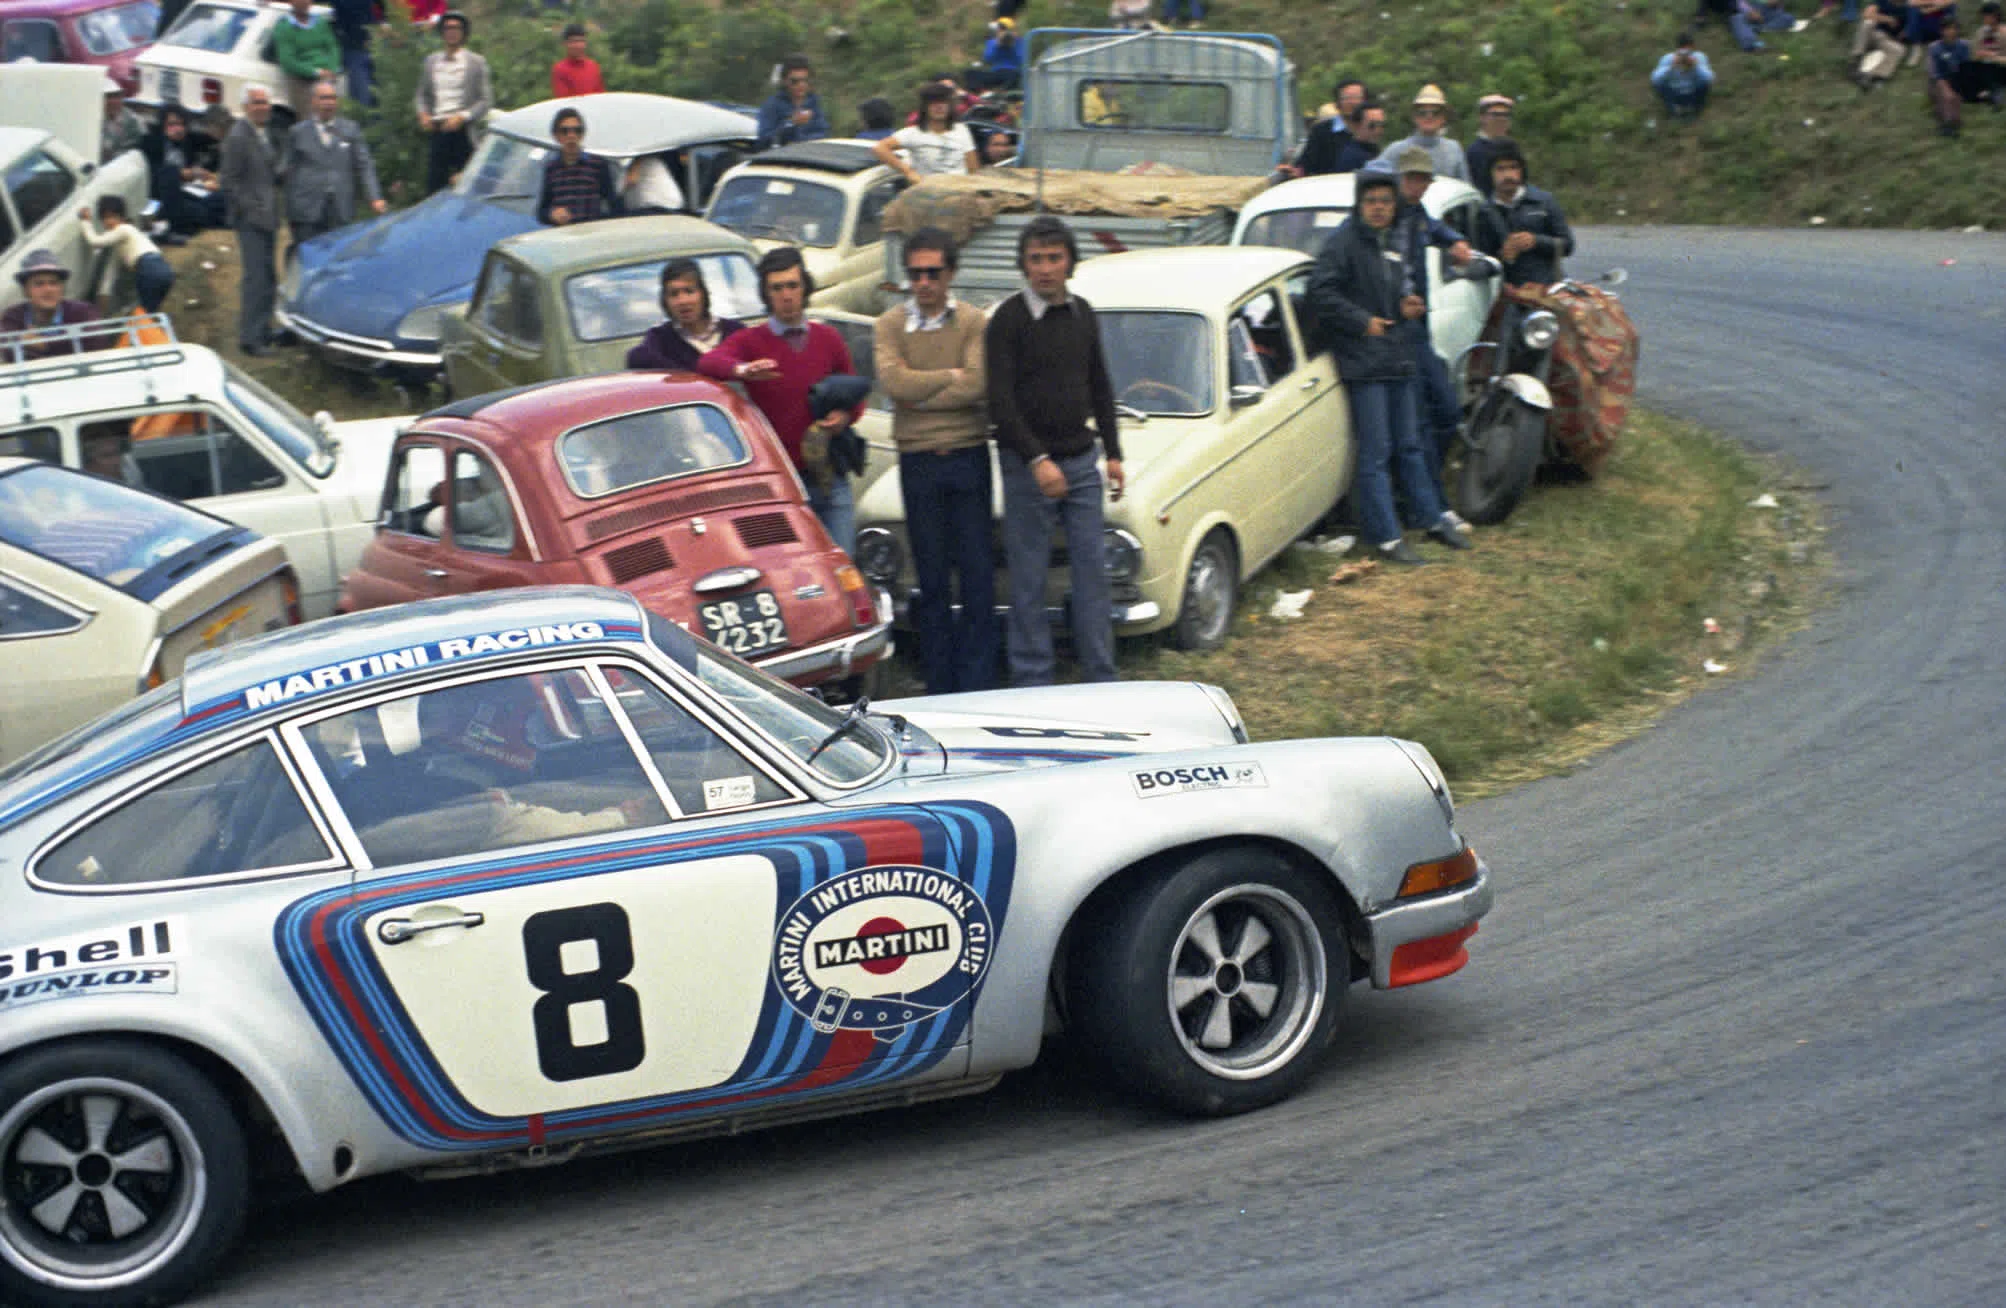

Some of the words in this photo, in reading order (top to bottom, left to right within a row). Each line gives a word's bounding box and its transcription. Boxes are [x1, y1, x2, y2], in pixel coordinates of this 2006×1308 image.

[702, 601, 743, 630] SR
[755, 592, 778, 616] 8
[245, 646, 429, 709] MARTINI
[439, 622, 604, 659] RACING
[1136, 766, 1229, 790] BOSCH
[780, 911, 812, 1001] MARTINI
[812, 871, 974, 919] INTERNATIONAL
[959, 922, 986, 975] CLUB
[819, 928, 944, 966] MARTINI
[522, 902, 646, 1082] 8
